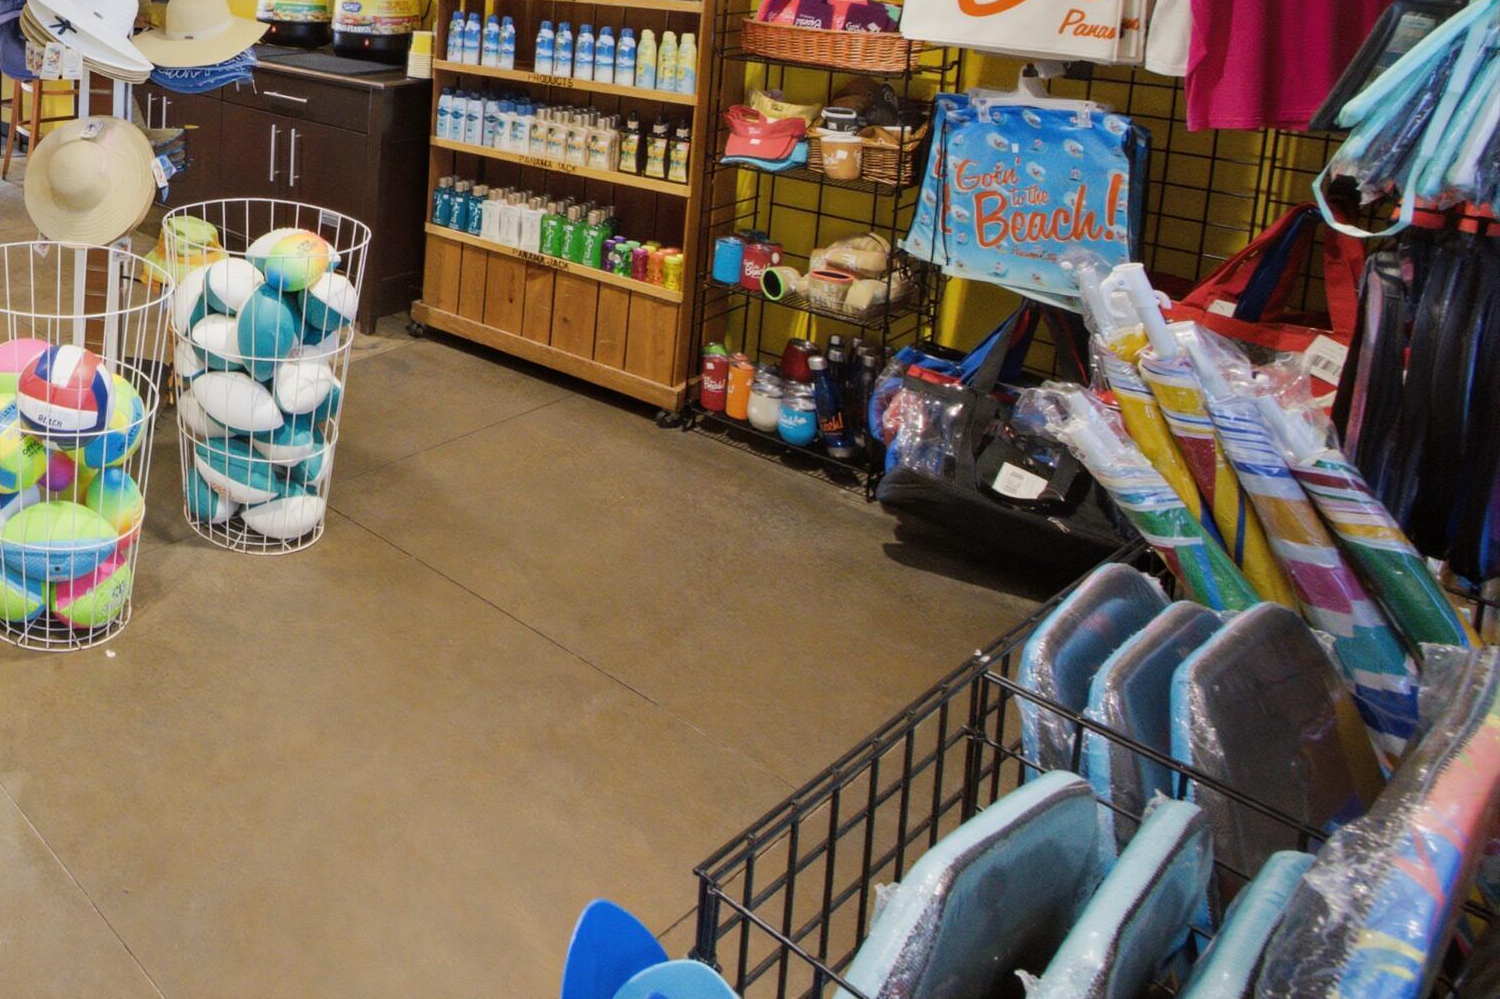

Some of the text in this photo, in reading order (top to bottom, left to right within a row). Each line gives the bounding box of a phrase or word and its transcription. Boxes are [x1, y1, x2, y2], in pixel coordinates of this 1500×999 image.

[527, 74, 574, 88] PRODUCTS
[518, 154, 579, 173] PANAMA JACK
[955, 155, 1021, 193] Goin'
[1025, 184, 1049, 205] the
[973, 172, 1124, 249] Beach!
[512, 248, 570, 270] PANAMA JACK
[37, 413, 63, 428] BEACH
